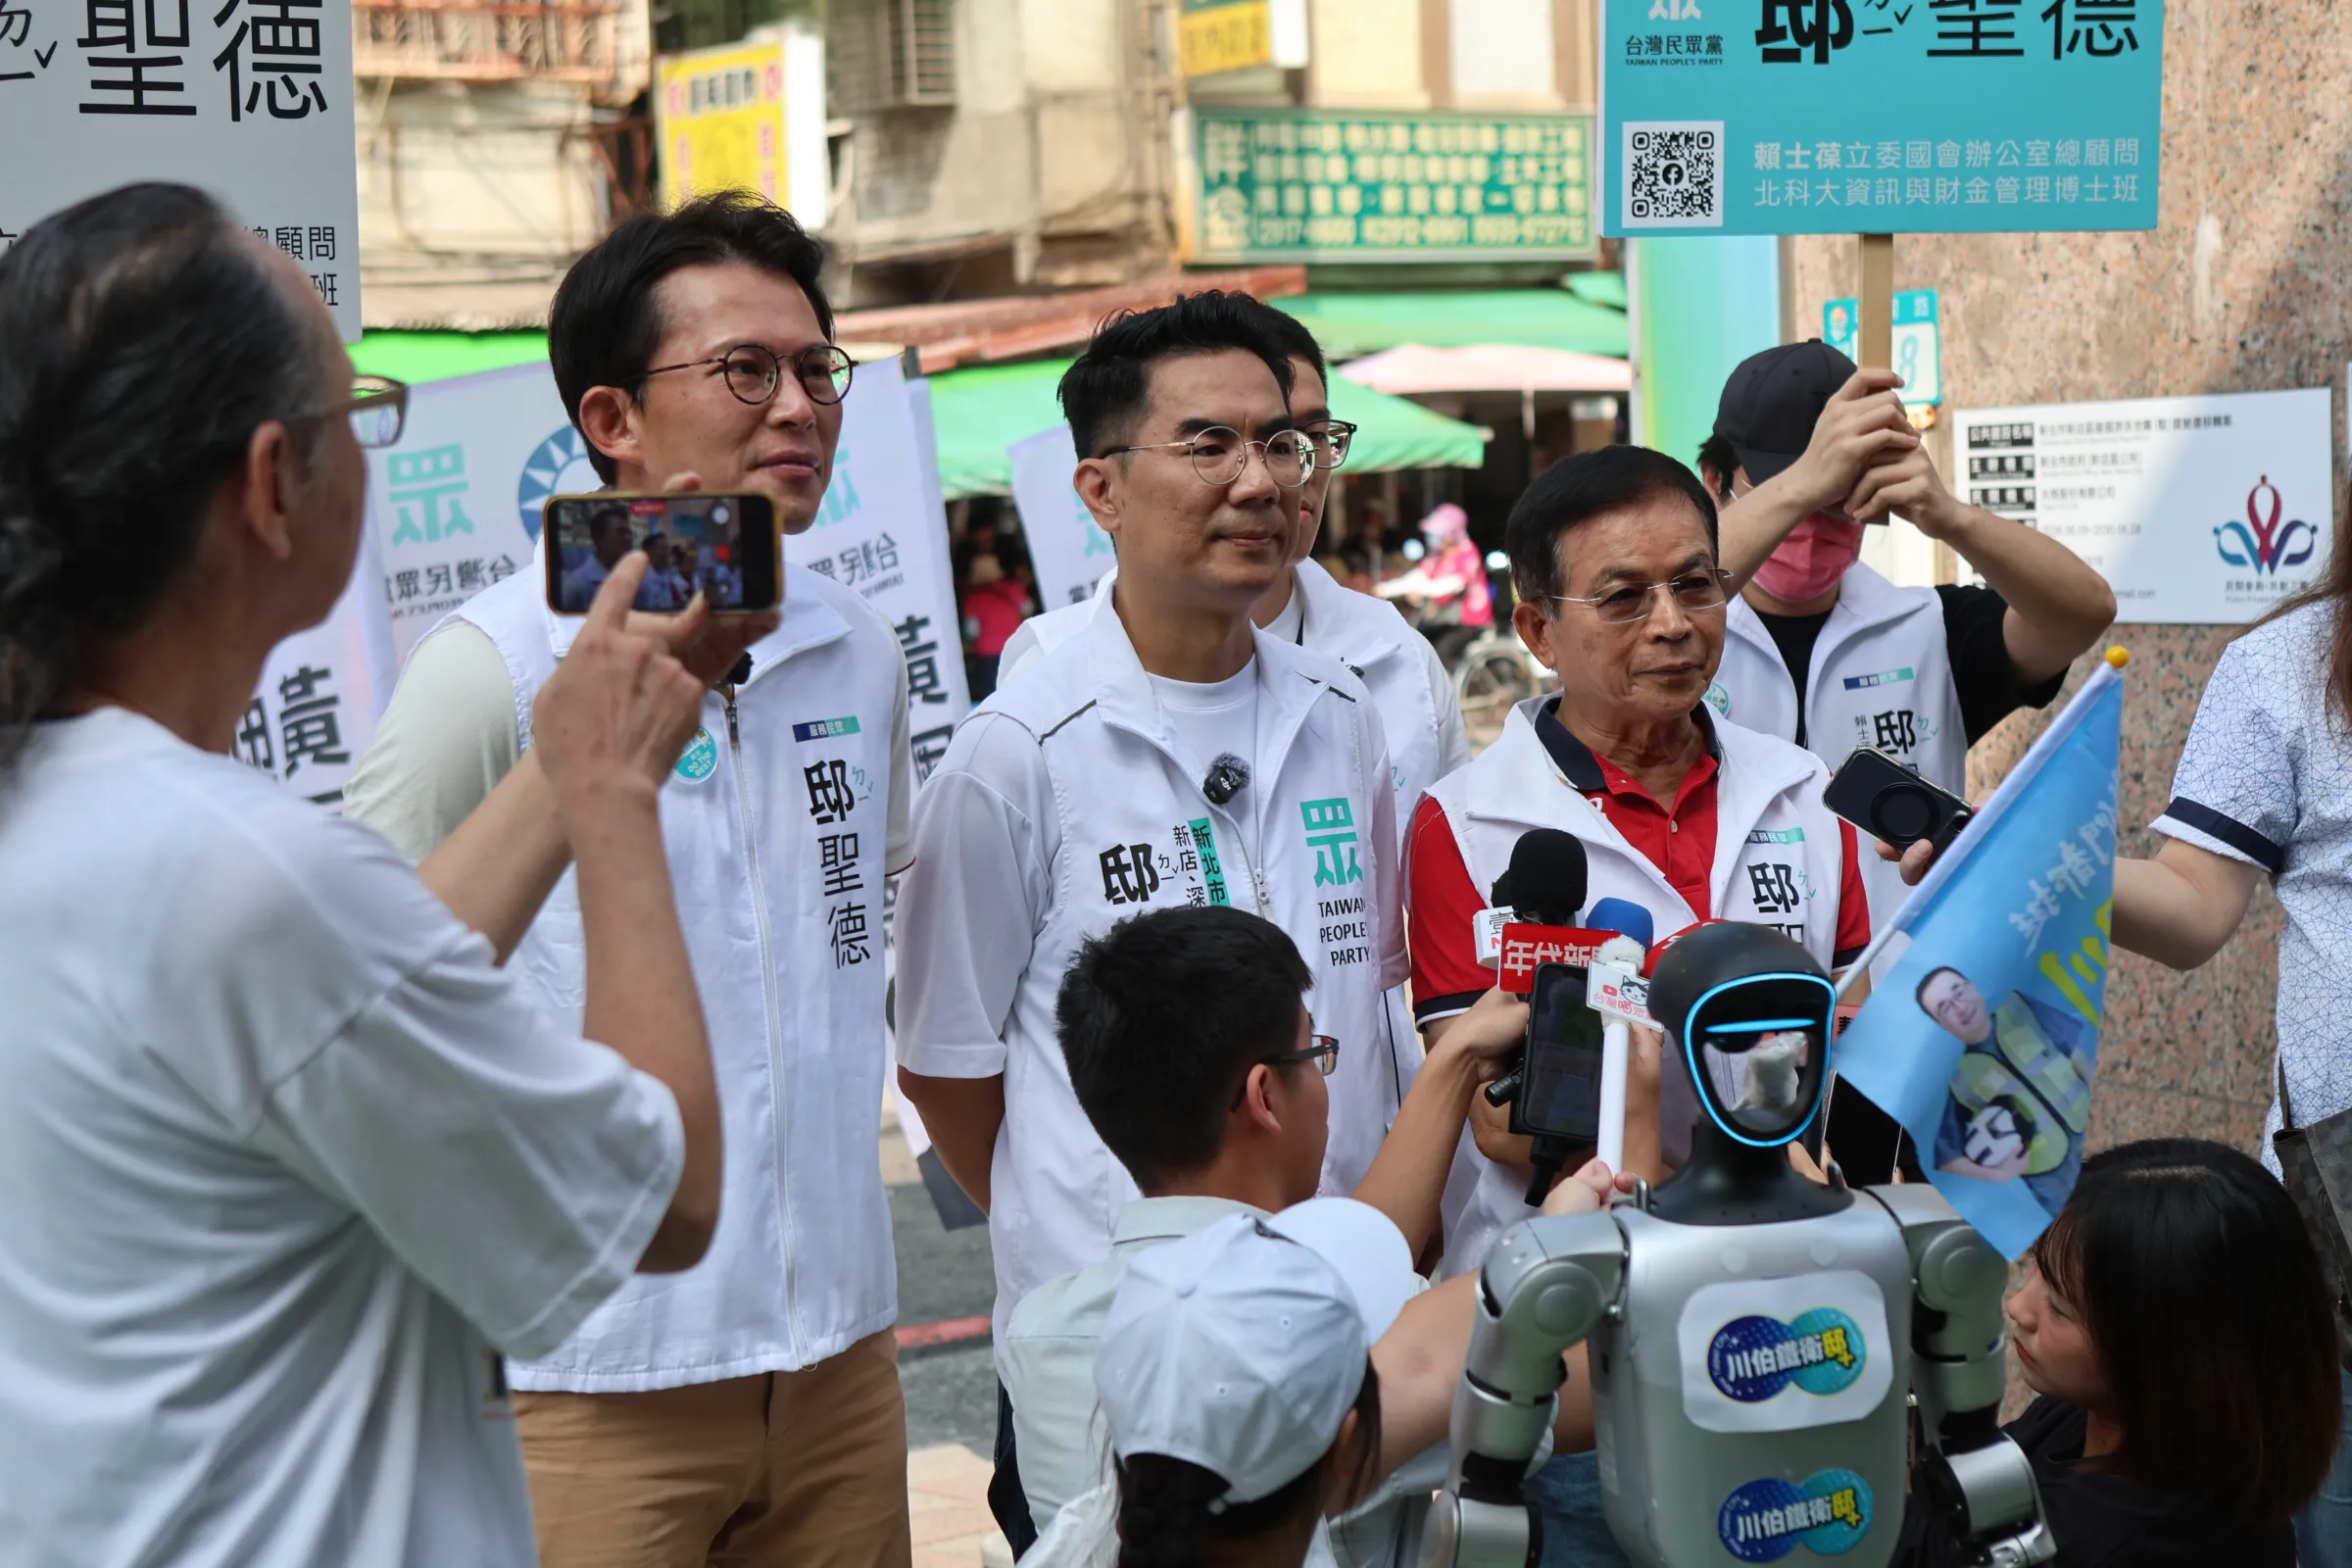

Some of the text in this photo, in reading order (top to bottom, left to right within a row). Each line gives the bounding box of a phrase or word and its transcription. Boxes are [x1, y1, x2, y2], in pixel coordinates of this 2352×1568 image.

[1625, 34, 1724, 56] 台灣民眾黨
[1754, 138, 2139, 171] 賴士葆立委國會辦公室總顧問
[1754, 174, 2139, 208] 北科大資訊與財金管理博士班
[1192, 824, 1226, 904] 新北市
[1331, 946, 1369, 966] PARTY
